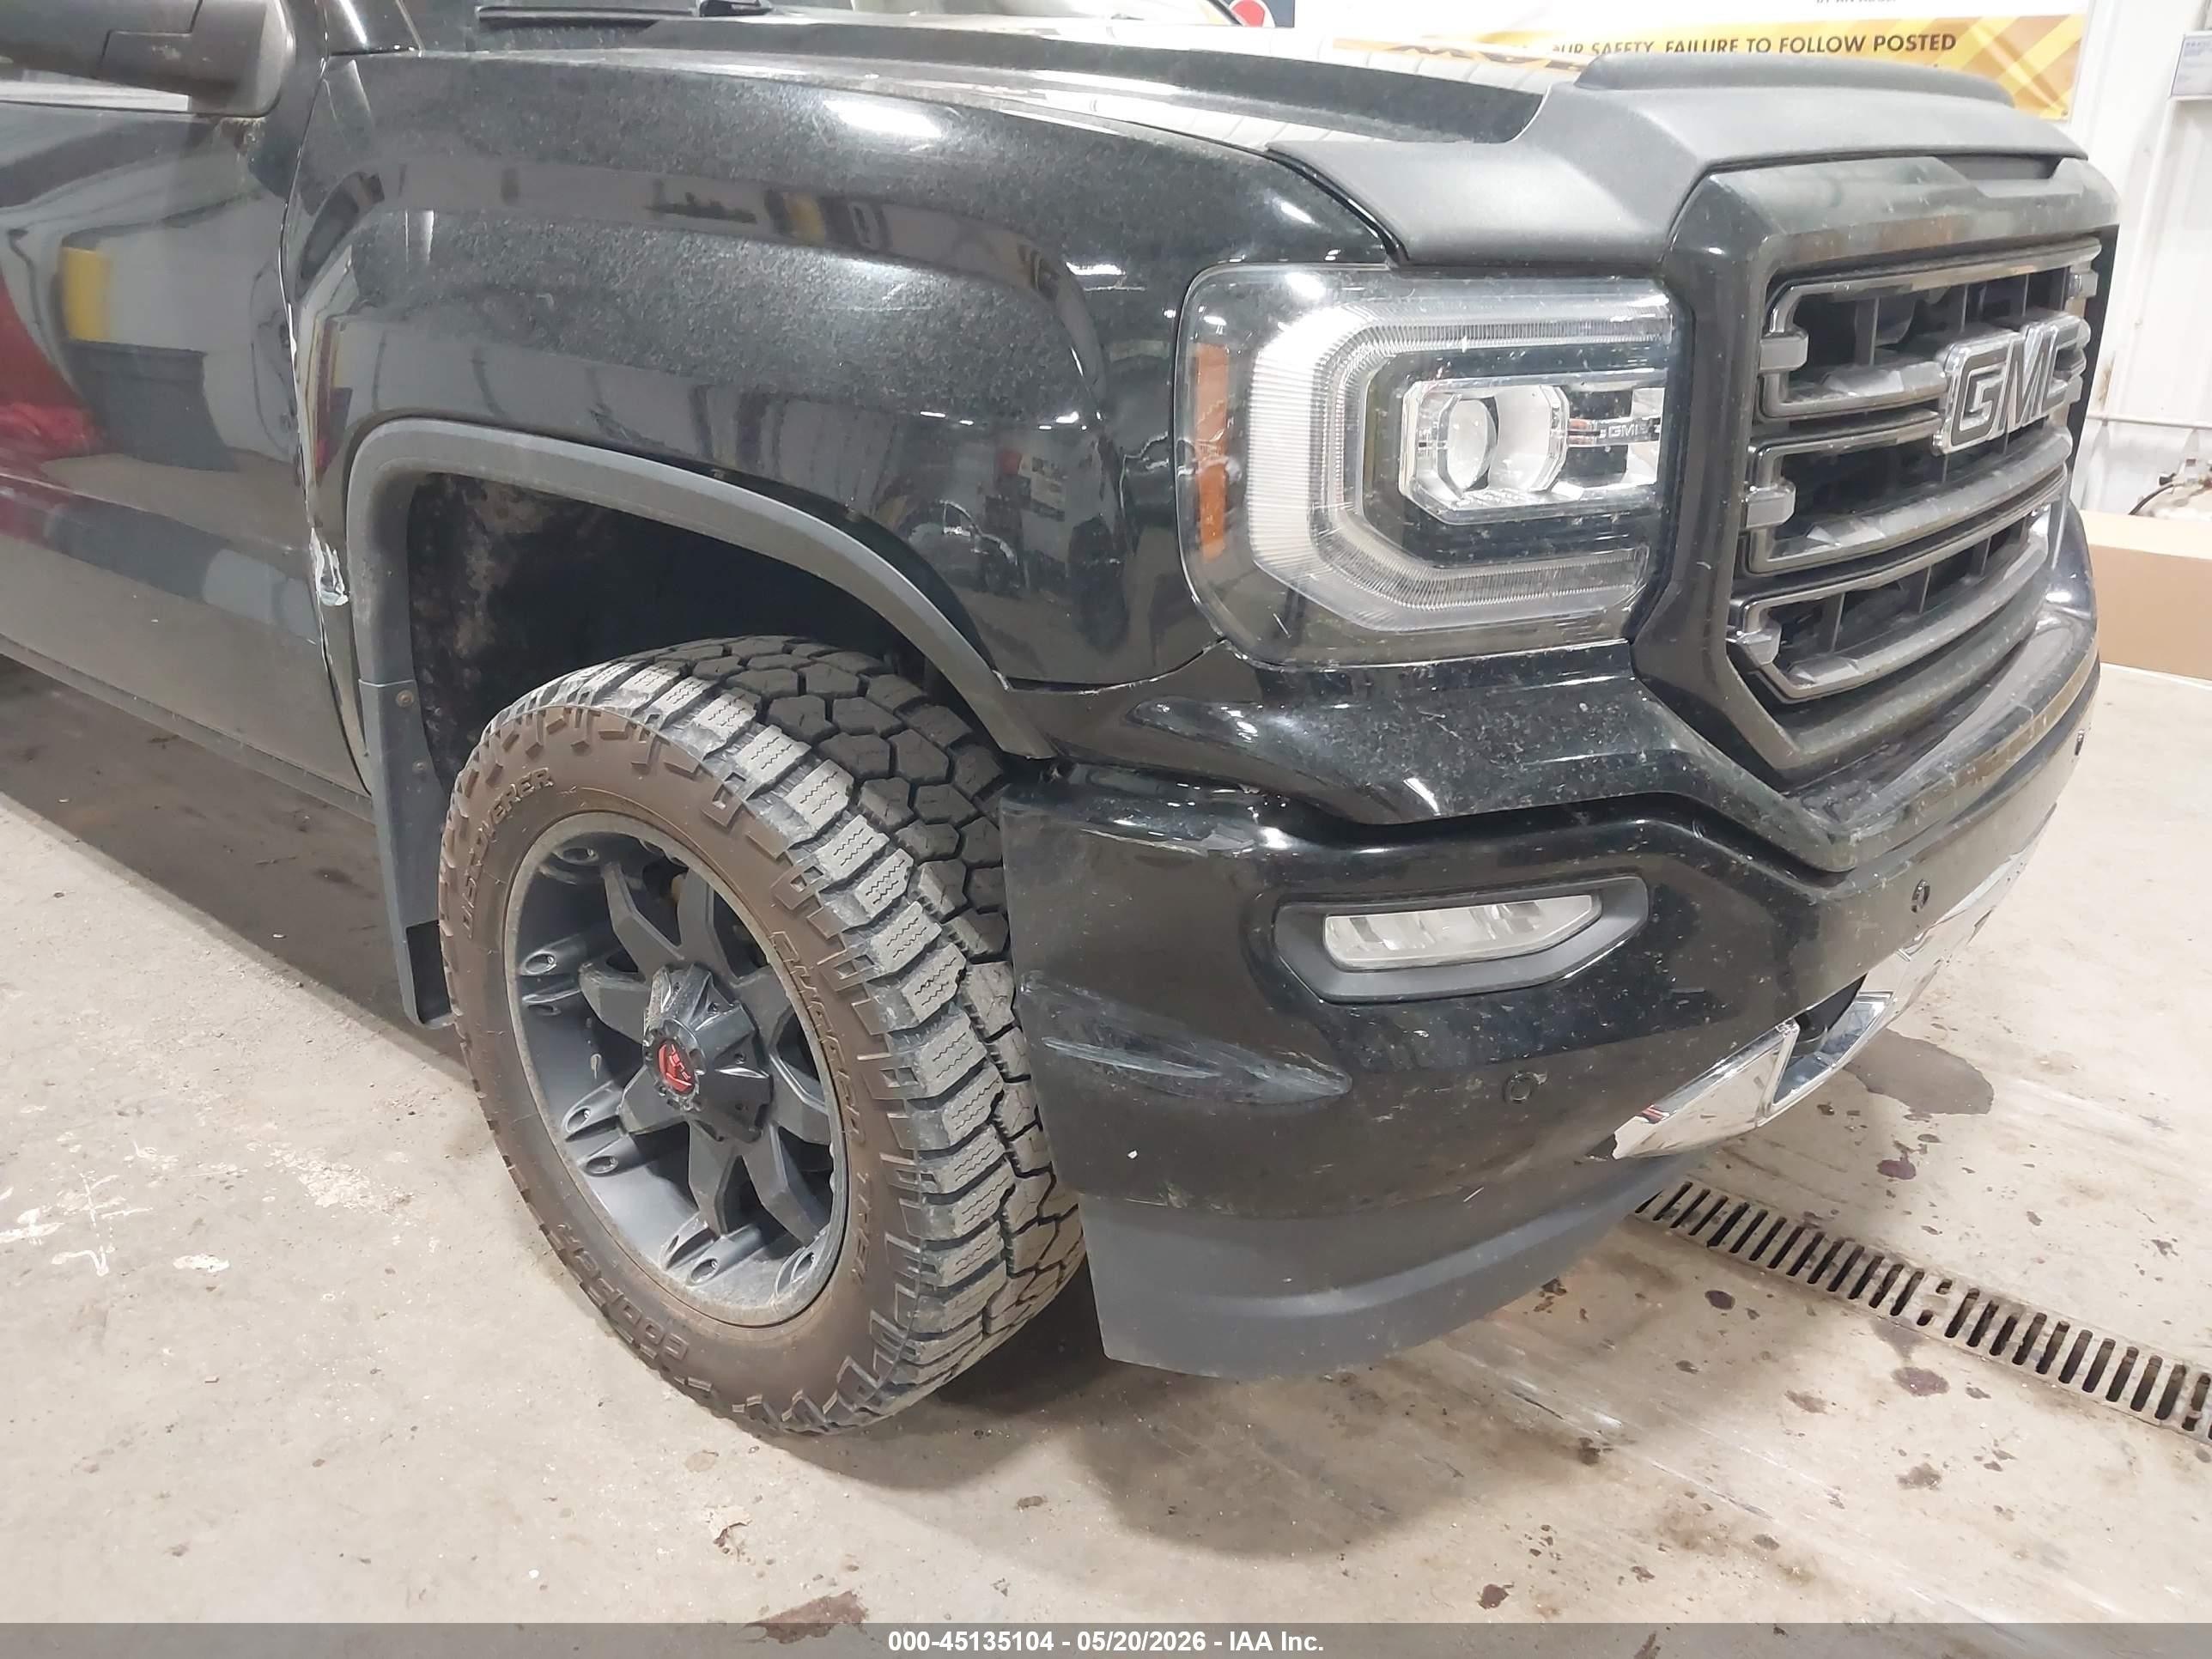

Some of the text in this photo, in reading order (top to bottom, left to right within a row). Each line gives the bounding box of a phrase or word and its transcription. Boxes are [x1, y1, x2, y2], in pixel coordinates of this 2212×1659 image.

[1666, 38, 1739, 53] FAILURE
[1746, 37, 1771, 53] TO
[1778, 34, 1867, 53] FOLLOW
[1873, 33, 1957, 52] POSTED
[1942, 314, 2083, 453] GMC
